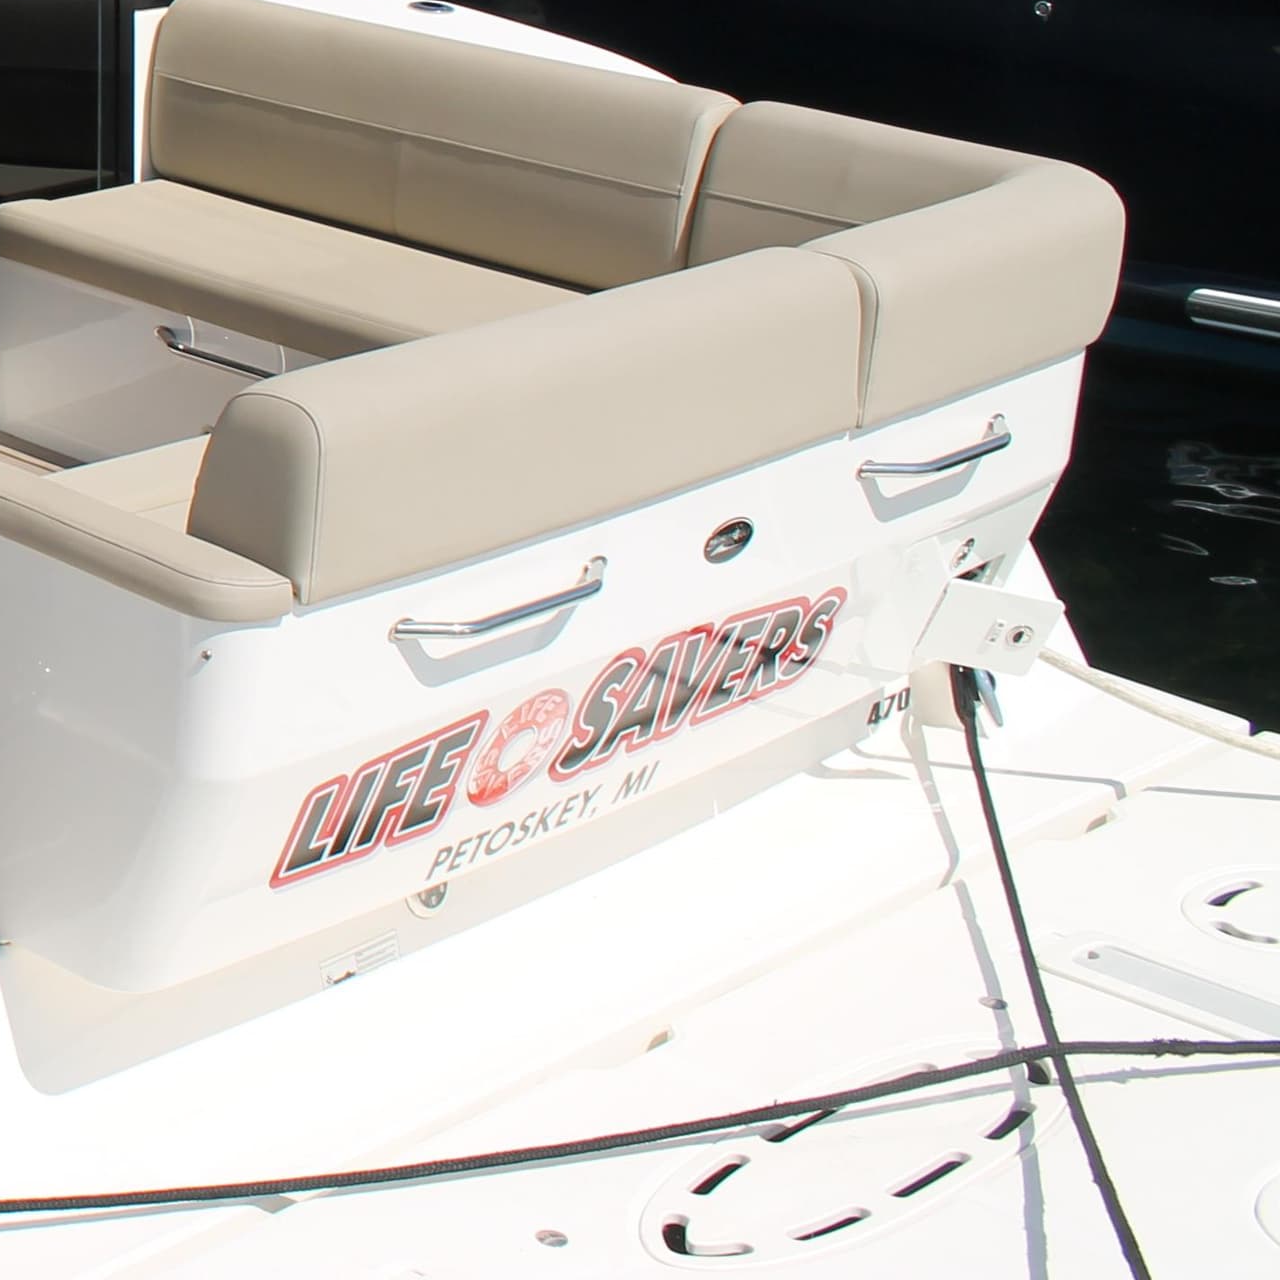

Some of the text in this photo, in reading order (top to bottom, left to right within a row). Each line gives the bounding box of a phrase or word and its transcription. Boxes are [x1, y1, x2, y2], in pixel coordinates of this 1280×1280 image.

[272, 590, 844, 884] LIFE SAVERS
[866, 687, 911, 725] 470
[425, 760, 660, 881] PETOSKEY, MI
